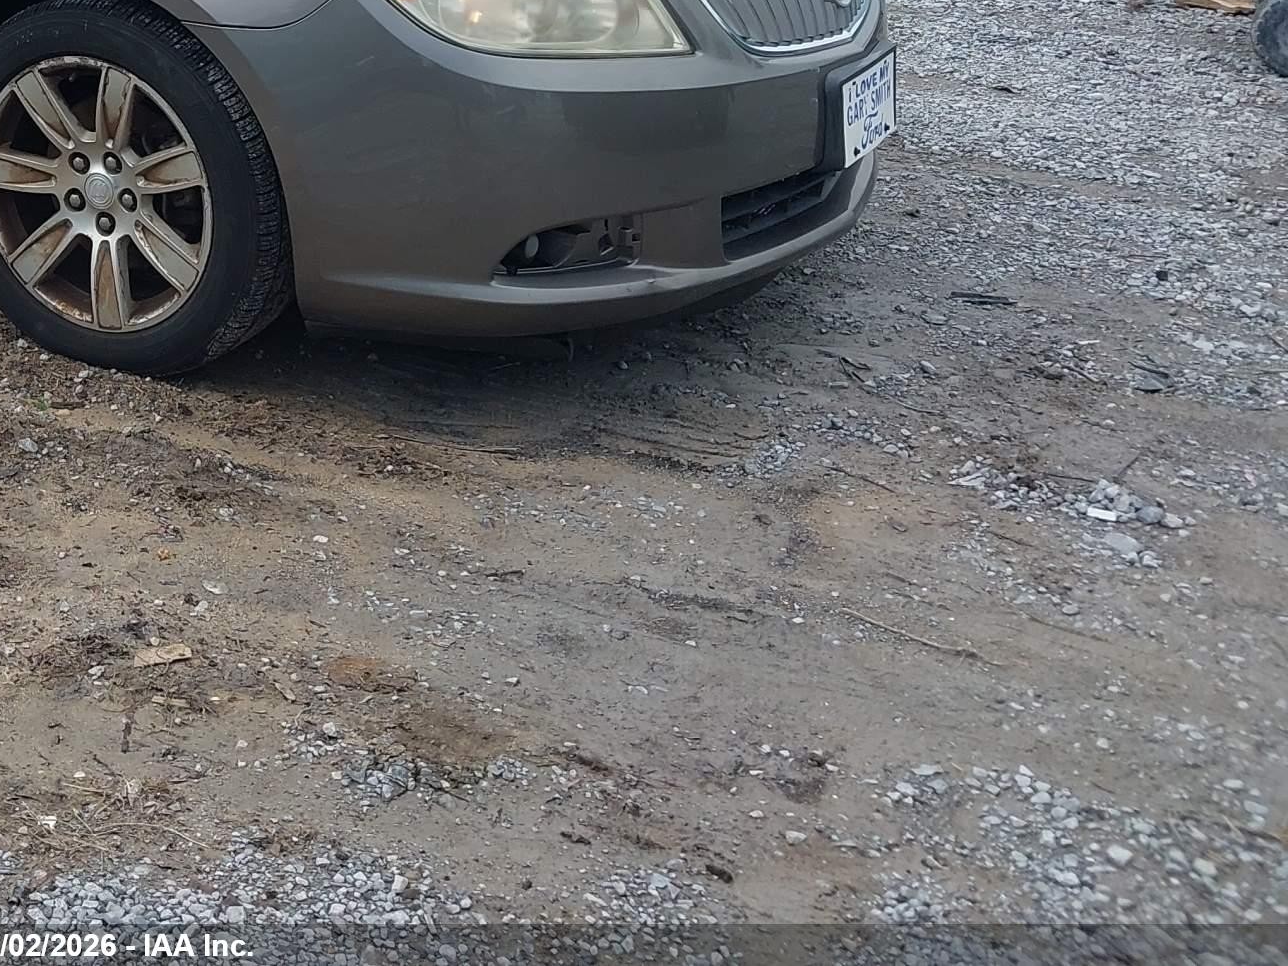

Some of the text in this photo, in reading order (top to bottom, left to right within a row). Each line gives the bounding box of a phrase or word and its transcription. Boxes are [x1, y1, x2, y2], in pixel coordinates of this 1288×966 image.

[855, 71, 878, 97] LOVE
[879, 62, 890, 82] MY
[870, 78, 891, 111] SMITH
[861, 110, 884, 149] Ford
